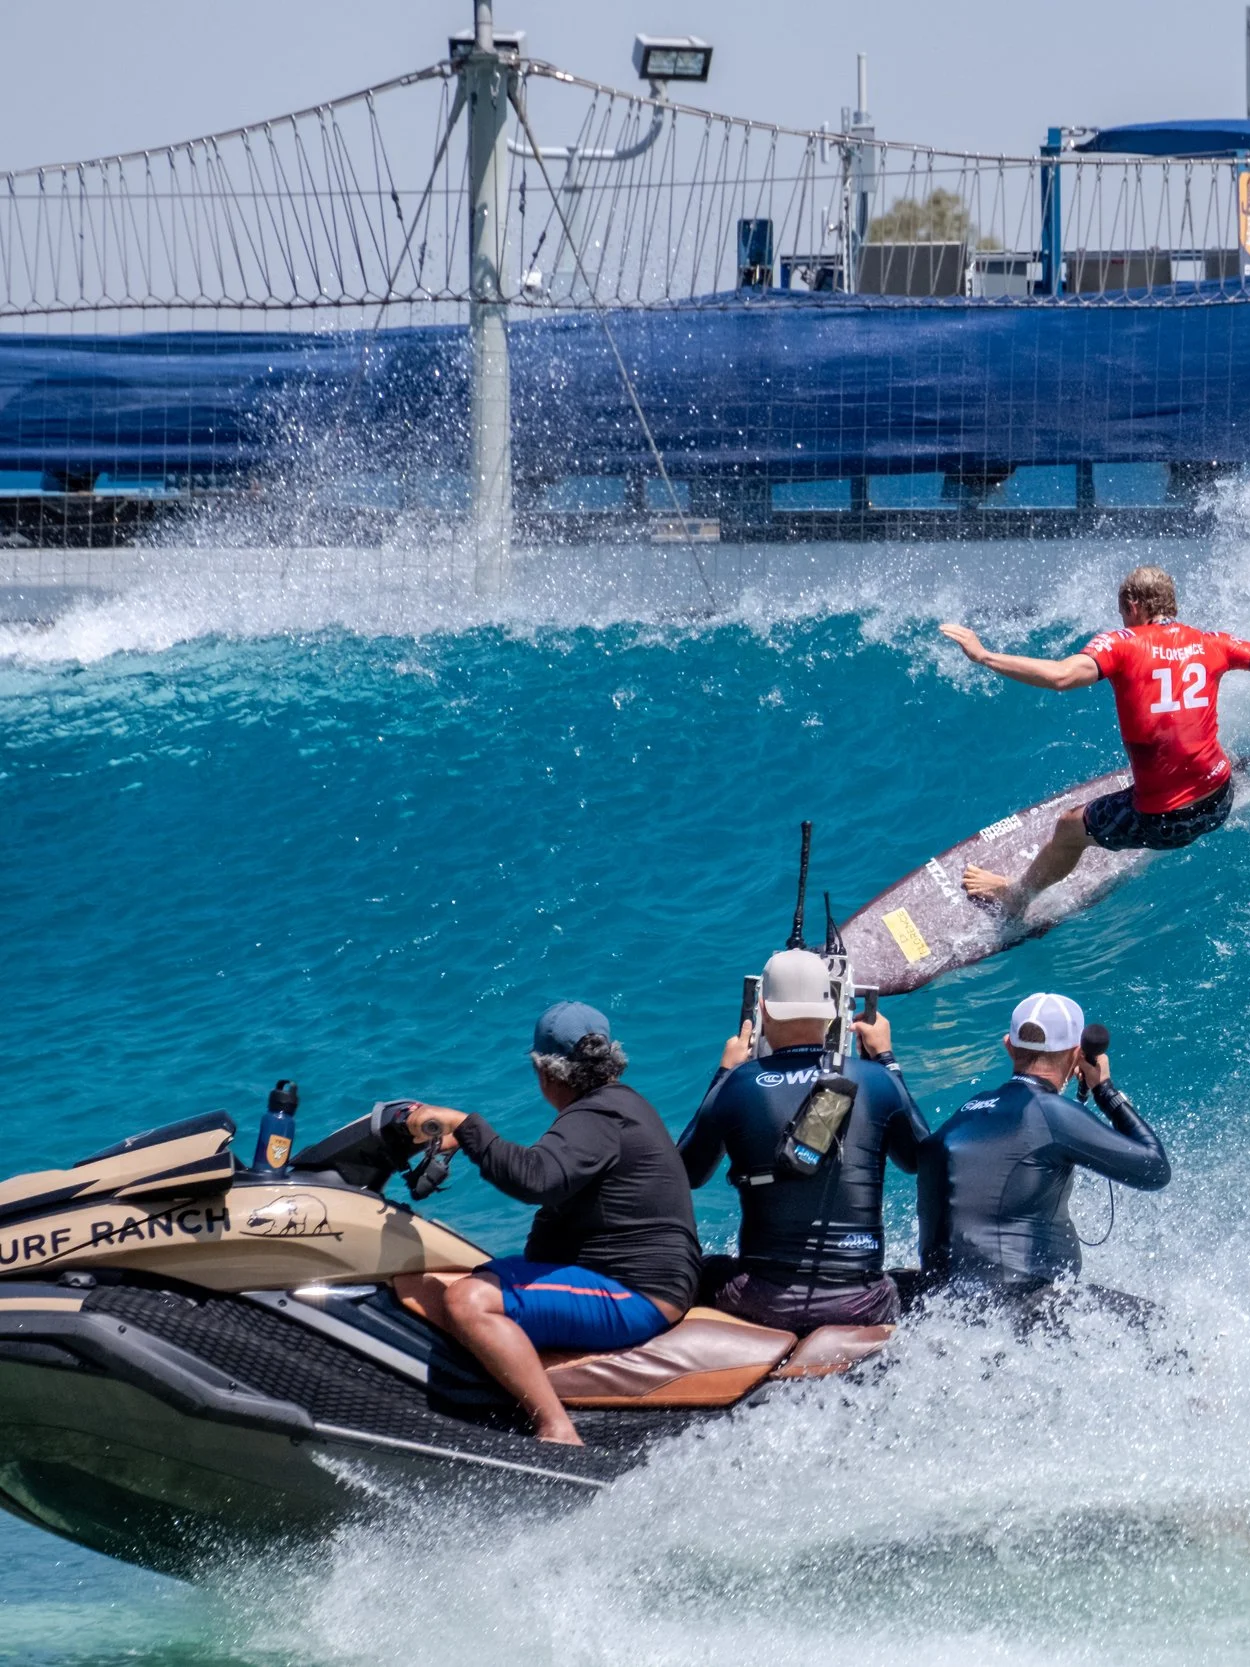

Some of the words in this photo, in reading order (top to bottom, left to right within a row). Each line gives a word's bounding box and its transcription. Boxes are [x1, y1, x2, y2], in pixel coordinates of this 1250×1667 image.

[1152, 643, 1205, 661] FLORENCE
[1150, 662, 1209, 714] 12
[983, 817, 1023, 843] MACHU
[925, 856, 959, 898] PYZEL
[91, 1206, 231, 1248] RANCH
